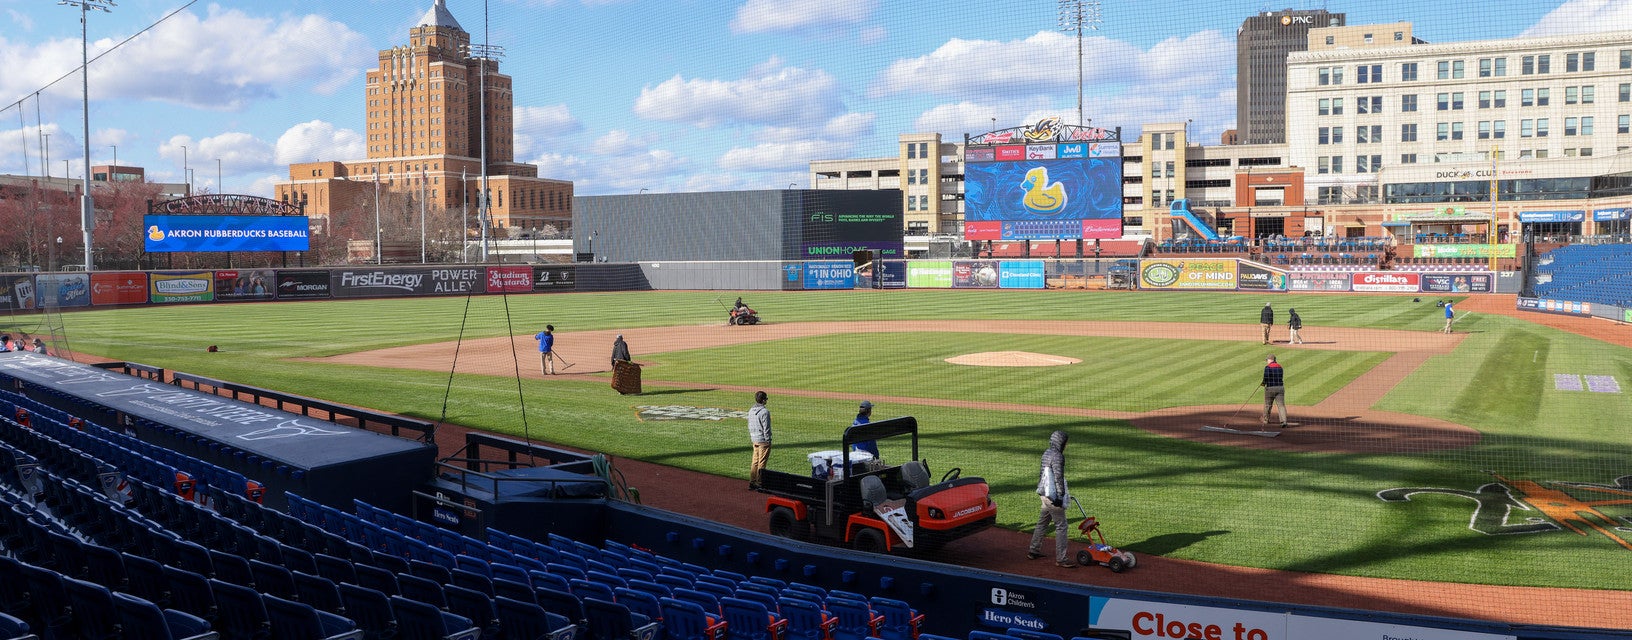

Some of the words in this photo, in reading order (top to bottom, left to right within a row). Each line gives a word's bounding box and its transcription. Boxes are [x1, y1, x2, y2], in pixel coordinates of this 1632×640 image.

[1292, 15, 1313, 24] PNC
[166, 197, 227, 213] CANAL
[237, 198, 287, 213] PARK
[167, 229, 202, 238] AKRON
[204, 229, 266, 238] RUBBERDUCKS
[268, 229, 307, 238] BASEBALL
[341, 271, 423, 287] FirstEnergy
[432, 269, 477, 281] POWER
[489, 270, 529, 280] Stadium
[809, 269, 818, 279] #1
[819, 269, 829, 279] IN
[830, 269, 852, 279] OHIO
[1188, 272, 1203, 280] OF
[1205, 272, 1234, 280] MIND
[159, 281, 207, 289] Blind&Sons
[434, 281, 475, 292] ALLEY
[953, 503, 983, 518] JACOBSEN
[434, 509, 446, 519] Hero
[446, 513, 459, 524] Seats
[1008, 591, 1025, 600] Akron
[1008, 599, 1035, 608] Children's
[985, 610, 1012, 624] Hero
[1014, 615, 1044, 630] Seats
[1132, 611, 1222, 640] Close
[1233, 622, 1268, 640] to
